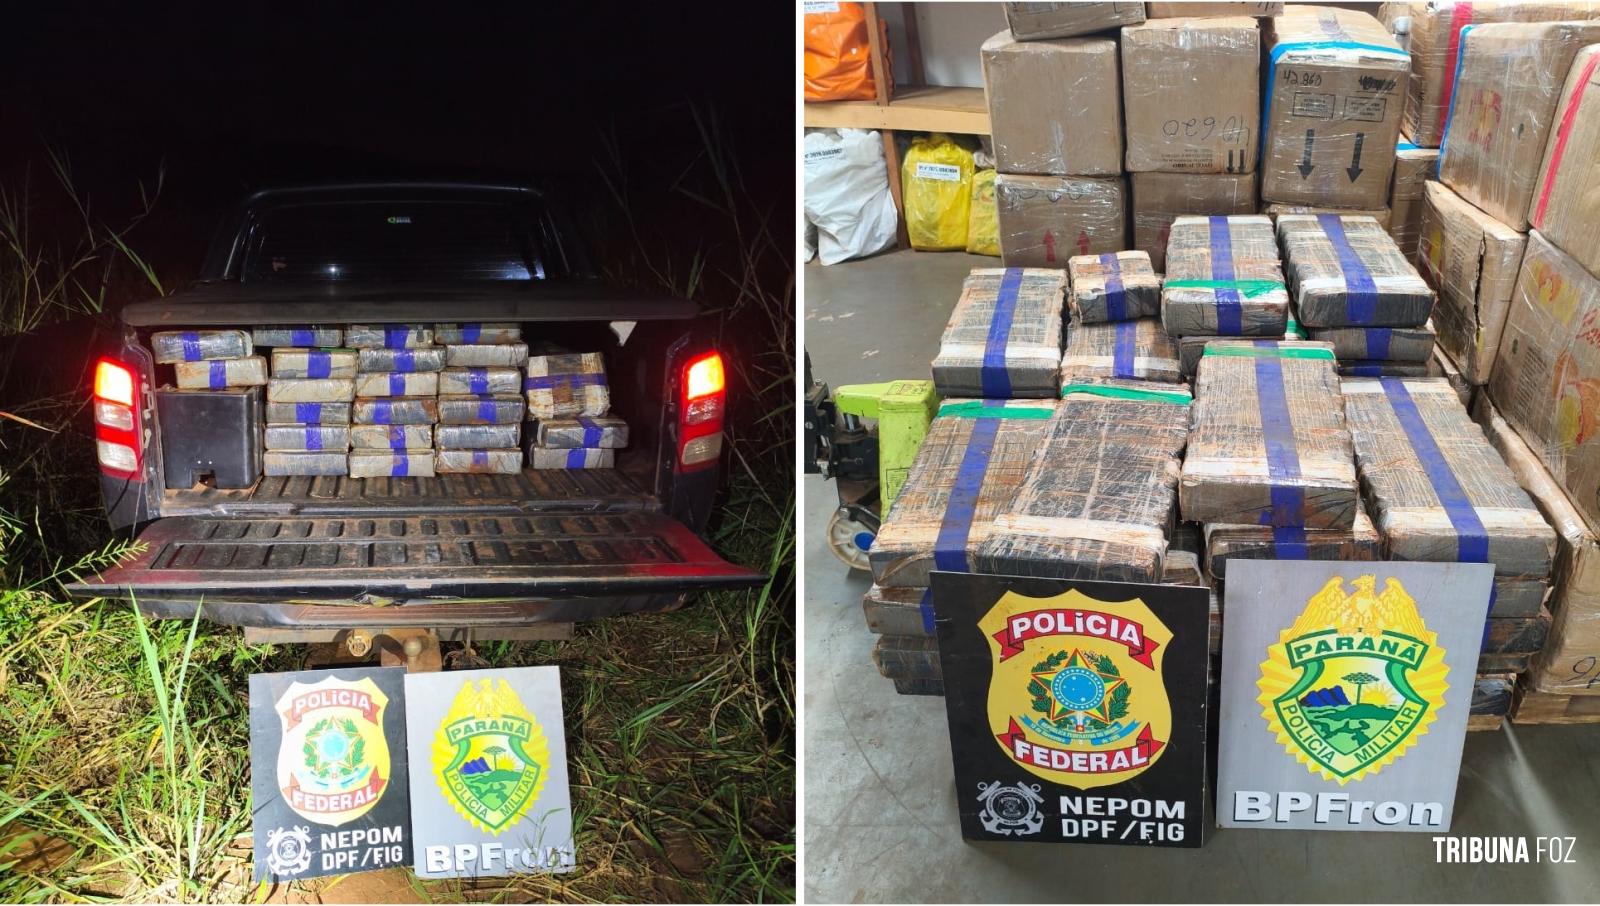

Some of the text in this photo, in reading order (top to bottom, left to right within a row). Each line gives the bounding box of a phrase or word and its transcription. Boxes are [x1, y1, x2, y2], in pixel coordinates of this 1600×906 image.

[1294, 636, 1418, 662] PARANÁ
[450, 720, 527, 740] PARANÁ
[1354, 707, 1418, 764] MILITAR
[1014, 740, 1149, 772] FEDERAL
[291, 785, 378, 811] FEDERAL
[501, 769, 535, 817] MILITAR
[1059, 795, 1186, 819] NEPOM
[1233, 790, 1444, 825] BPFron
[321, 826, 403, 851] NEPOM
[1061, 818, 1186, 842] DPF/FIG
[321, 846, 403, 871] DPF/FIG
